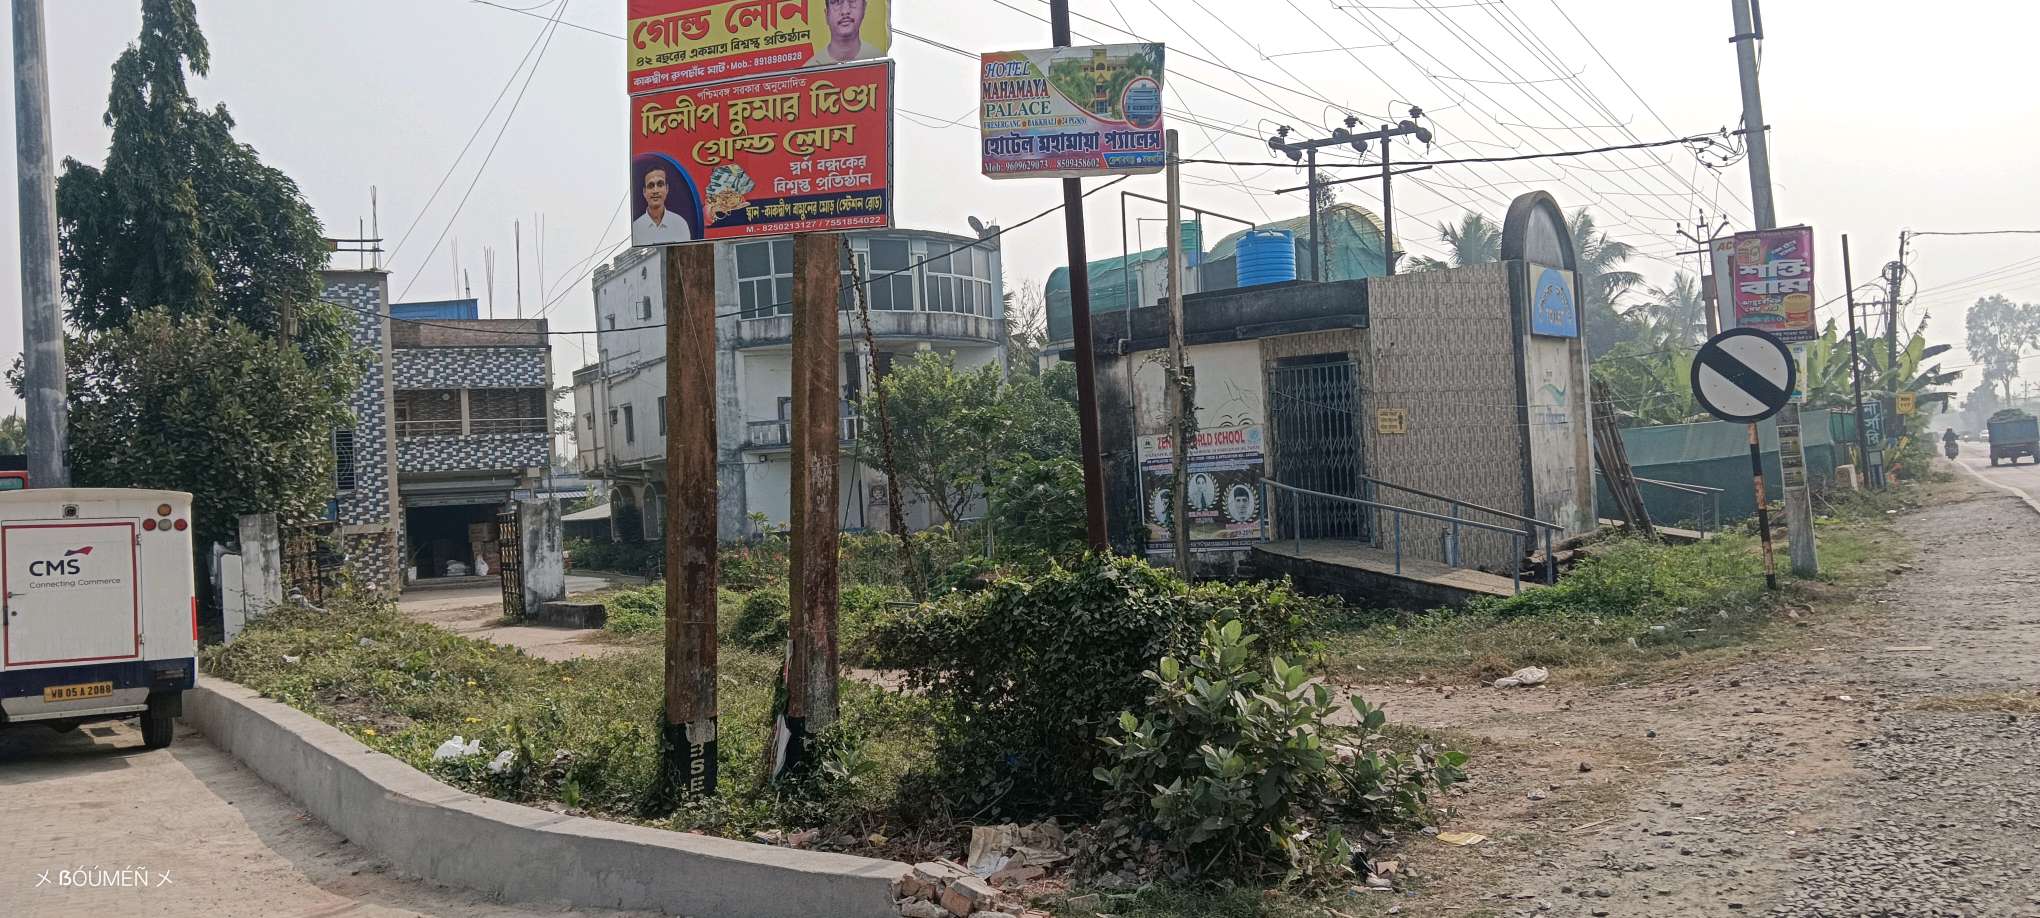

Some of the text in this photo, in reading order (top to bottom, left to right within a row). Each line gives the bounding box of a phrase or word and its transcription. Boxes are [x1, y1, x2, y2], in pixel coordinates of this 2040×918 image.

[633, 0, 808, 49] গোল্ড লোন
[655, 50, 687, 65] বছরের
[690, 42, 728, 58] একমাত্র
[763, 28, 811, 46] প্রতিষ্ঠান
[633, 70, 669, 86] কাকদ্বীপ
[985, 60, 1031, 79] HOTEL
[697, 77, 807, 100] পশ্চিমবঙ্গ সরকার অনুমোদিত
[982, 78, 1049, 99] MAHAMAYA
[641, 95, 719, 136] দিলীপ
[728, 92, 800, 134] কুমার
[986, 101, 1052, 118] PALACE
[692, 124, 857, 164] গোল্ড লোন
[984, 131, 1034, 156] হোটেল
[1104, 130, 1161, 150] প্যালেস
[790, 155, 867, 175] স্বর্ণ বন্ধকের
[816, 169, 872, 191] প্রতিষ্ঠান
[762, 221, 816, 232] 8250213127
[1214, 430, 1246, 445] SCHOOL
[29, 559, 81, 577] CMS
[29, 577, 121, 590] Connecting Commerce
[66, 687, 77, 697] 05
[80, 687, 85, 696] A
